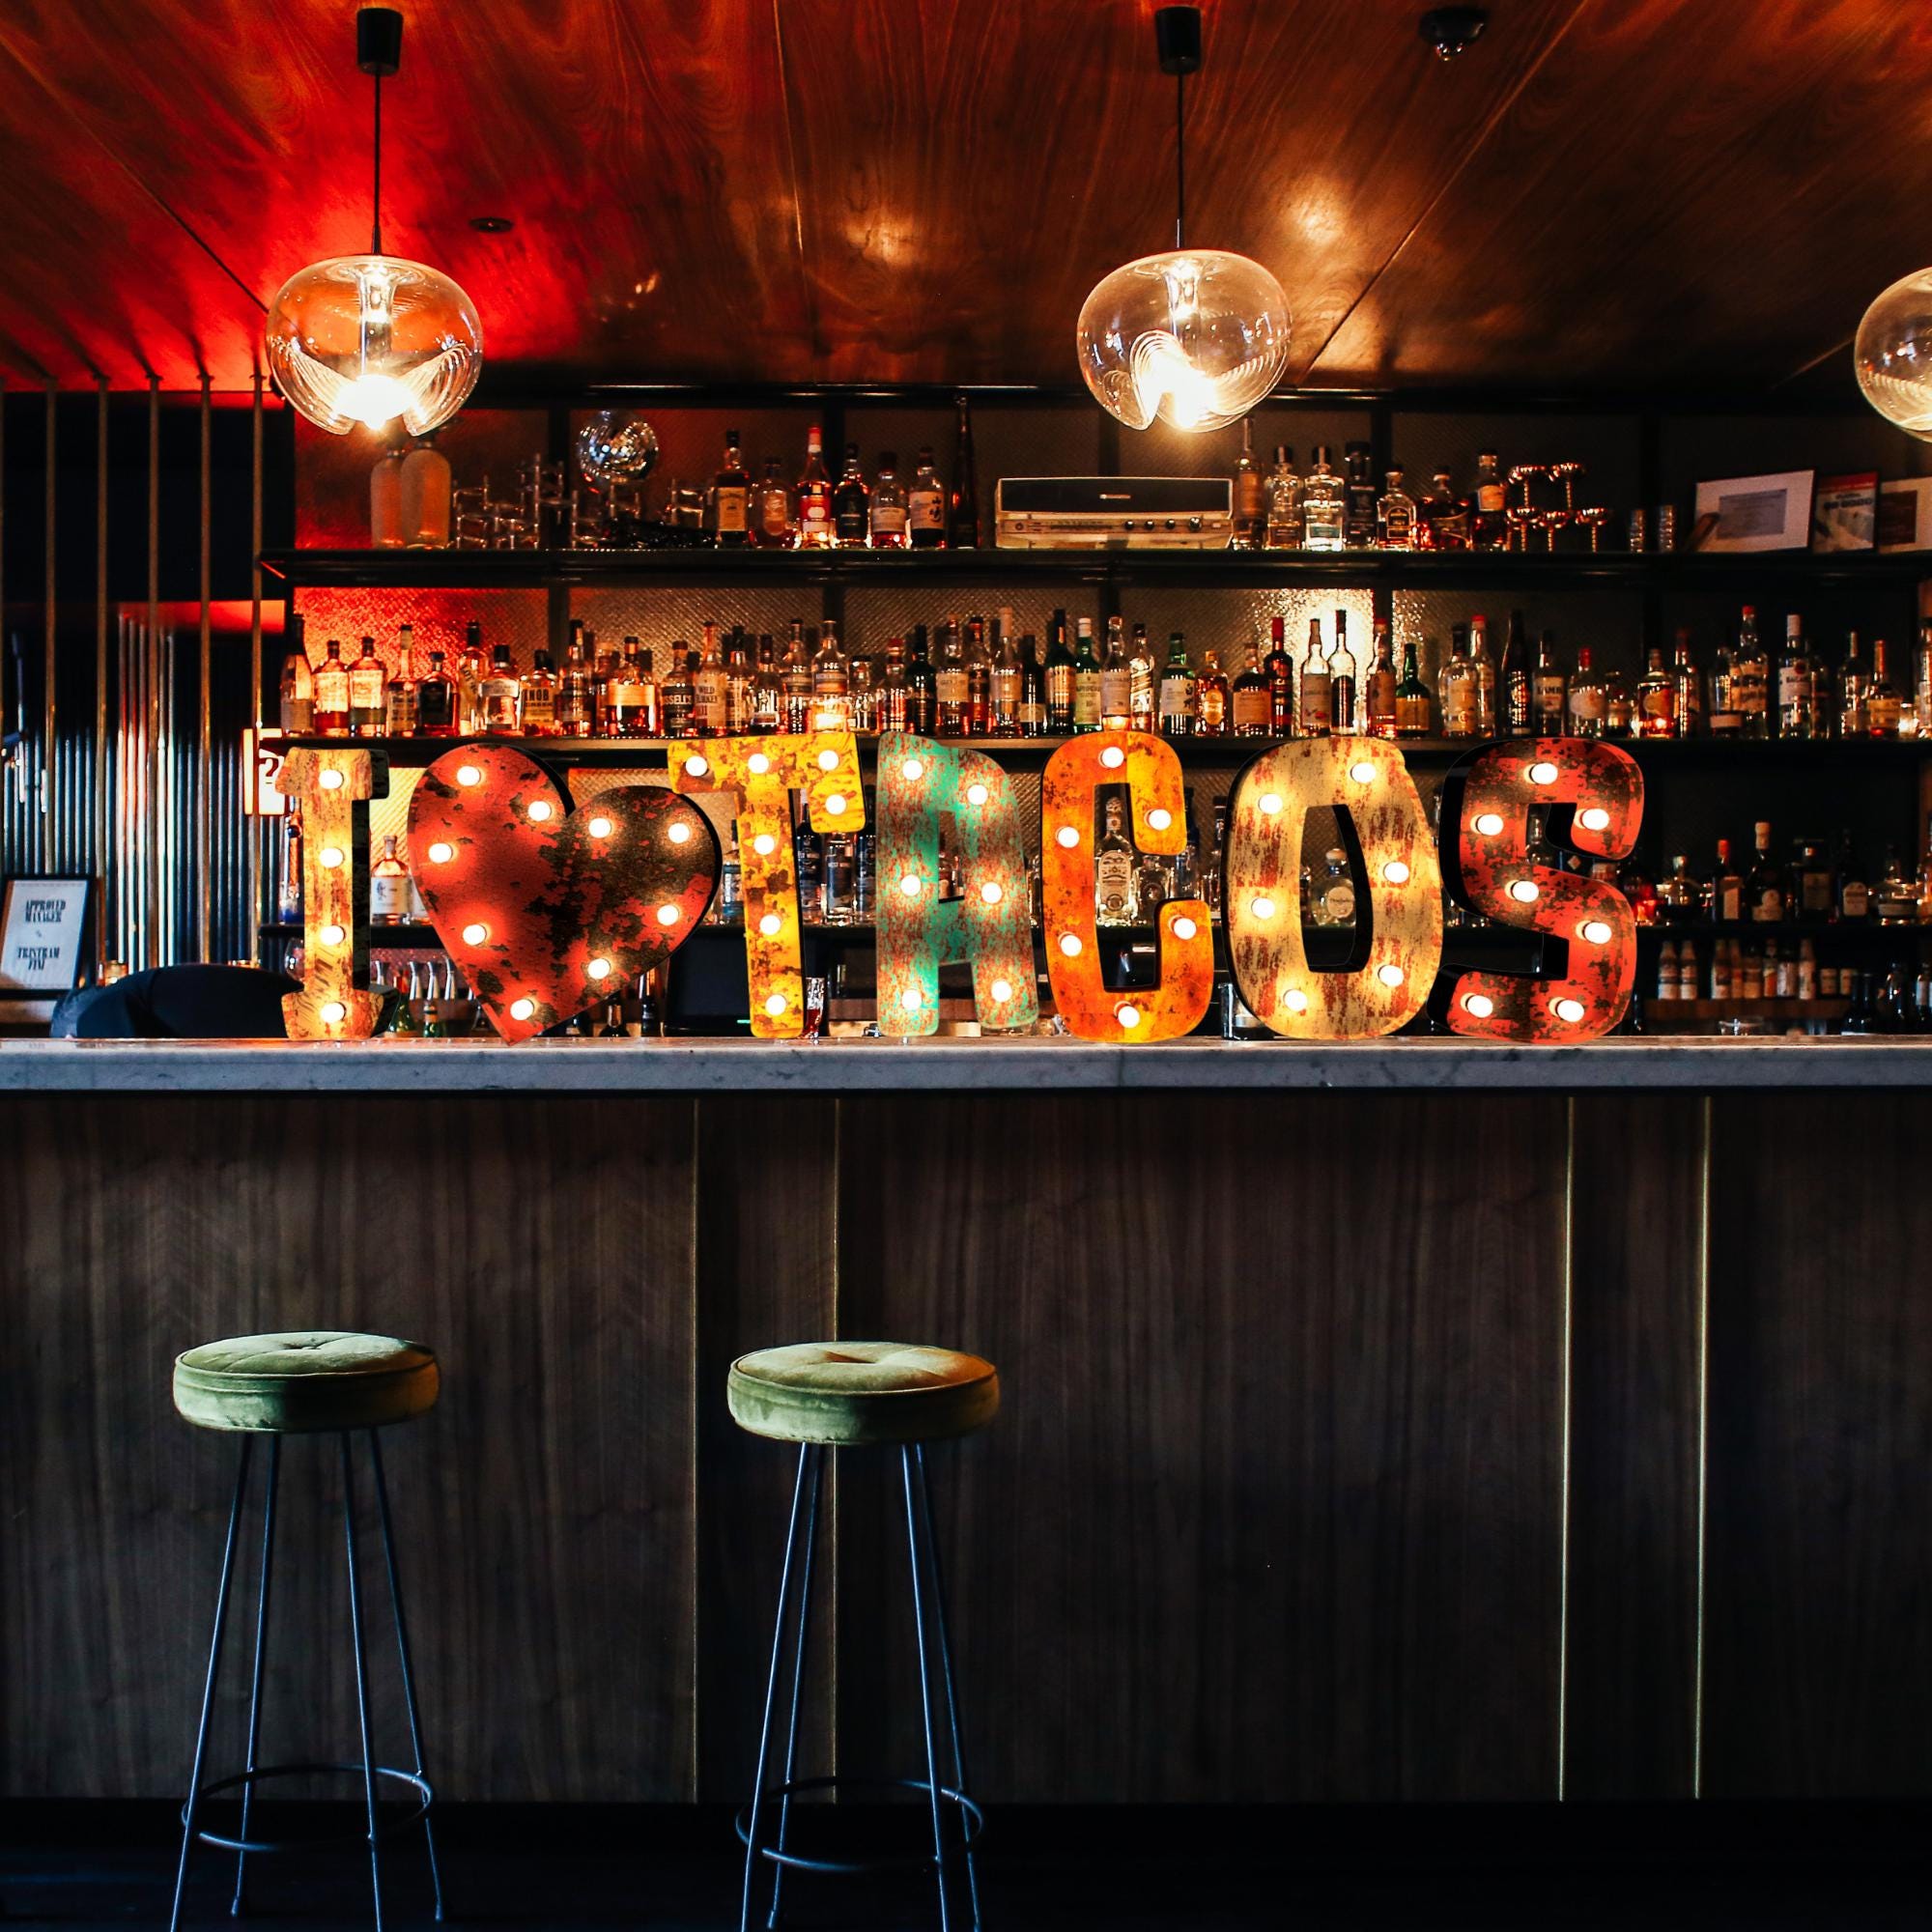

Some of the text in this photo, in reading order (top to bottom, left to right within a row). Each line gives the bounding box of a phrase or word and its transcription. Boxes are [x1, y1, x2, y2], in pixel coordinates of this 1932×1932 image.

[663, 695, 693, 705] SSELL'S
[275, 731, 1645, 1044] I TACOS
